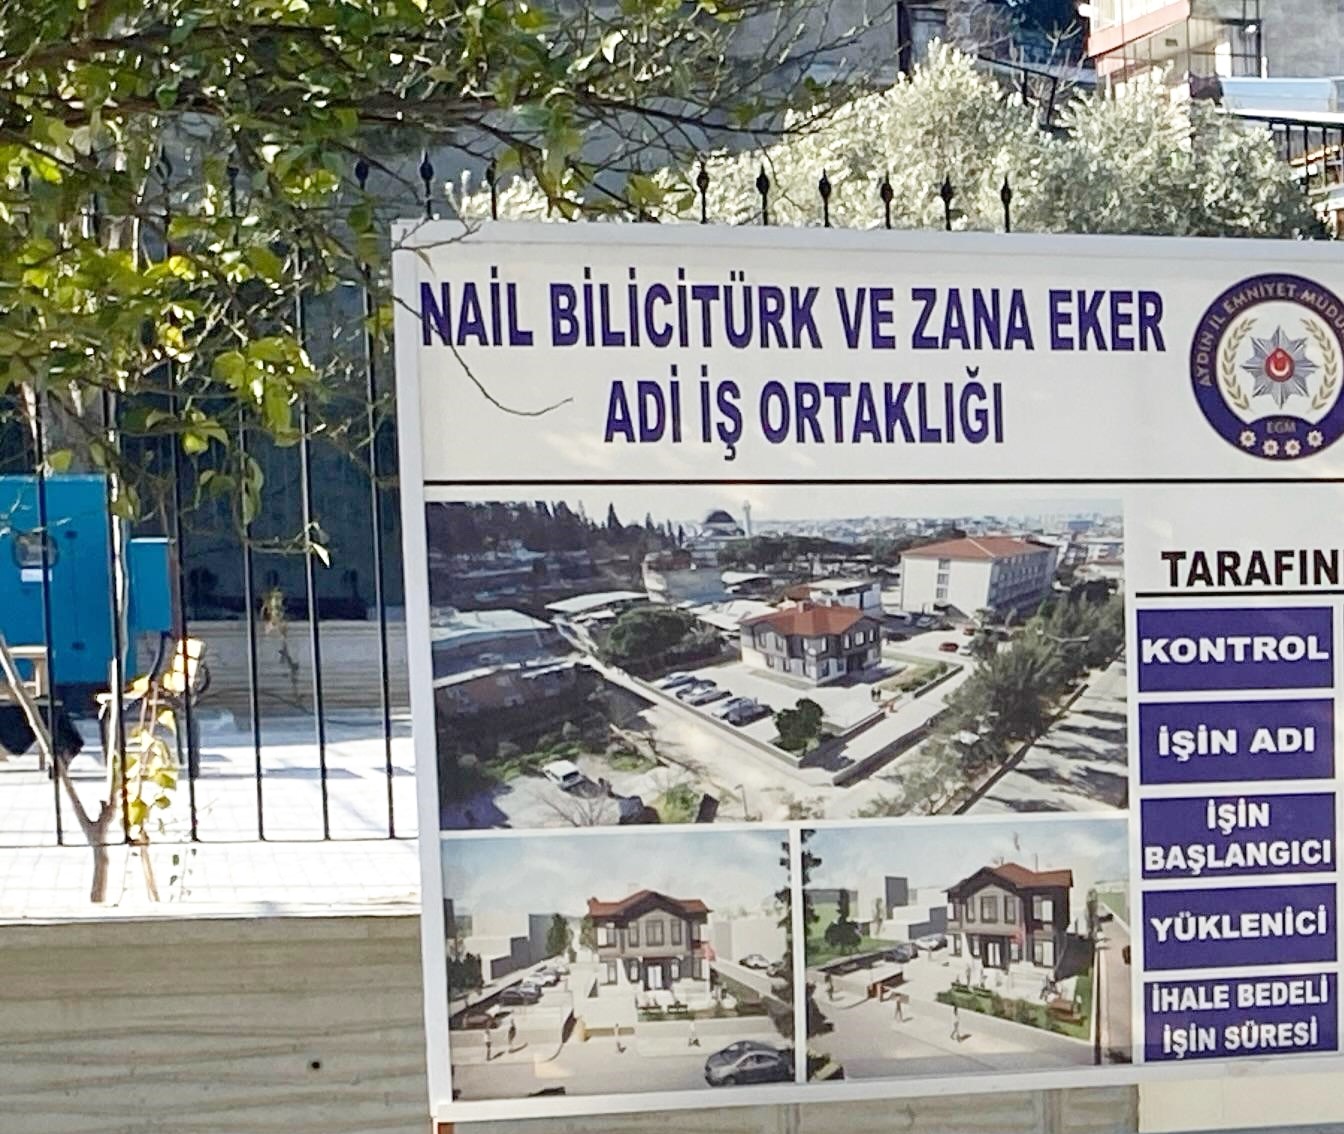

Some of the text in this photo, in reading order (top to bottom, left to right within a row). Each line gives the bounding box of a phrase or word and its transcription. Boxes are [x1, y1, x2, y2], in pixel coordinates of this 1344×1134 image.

[420, 266, 1166, 352] NAİL BİLİCİTÜRK VE ZANA EKER
[604, 364, 1004, 461] ADİ İŞ ORTAKLIĞI
[1142, 636, 1329, 663] KONTROL
[1159, 724, 1315, 762] İŞİN ADI
[1207, 797, 1270, 835] İŞİN
[1144, 839, 1331, 875] BAŞLANGICI
[1150, 904, 1327, 942] YÜKLENİCİ
[1152, 974, 1328, 1012] İHALE BEDELİ
[1163, 1015, 1318, 1059] İŞİN SÜRESİ
